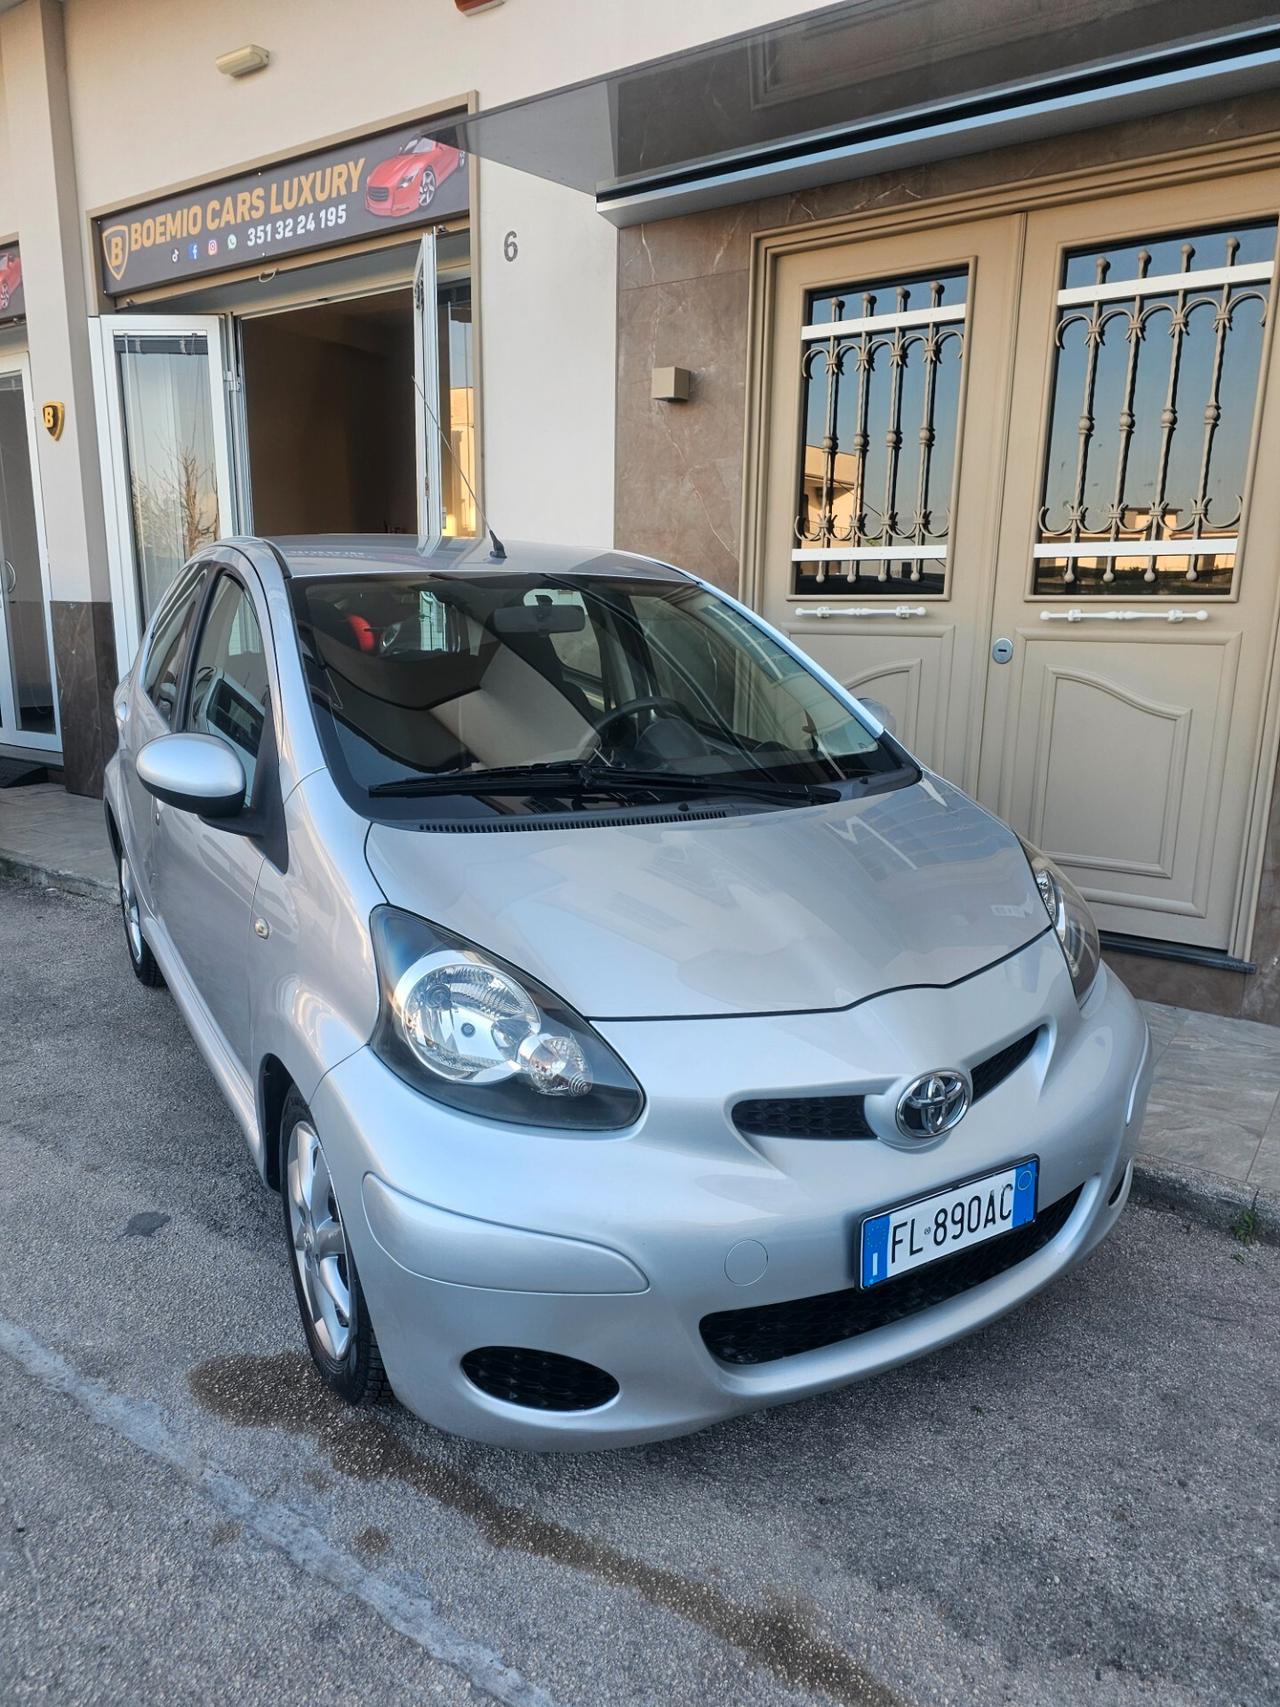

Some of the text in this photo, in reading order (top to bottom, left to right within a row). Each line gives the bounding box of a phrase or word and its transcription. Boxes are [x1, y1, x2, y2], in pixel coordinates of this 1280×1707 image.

[131, 158, 366, 251] BOEMIO CARS LUXURY
[247, 204, 347, 246] 351 32 24 195
[110, 236, 123, 267] B
[504, 230, 518, 262] 6
[44, 406, 54, 428] B
[891, 1183, 1014, 1264] FL 890AC
